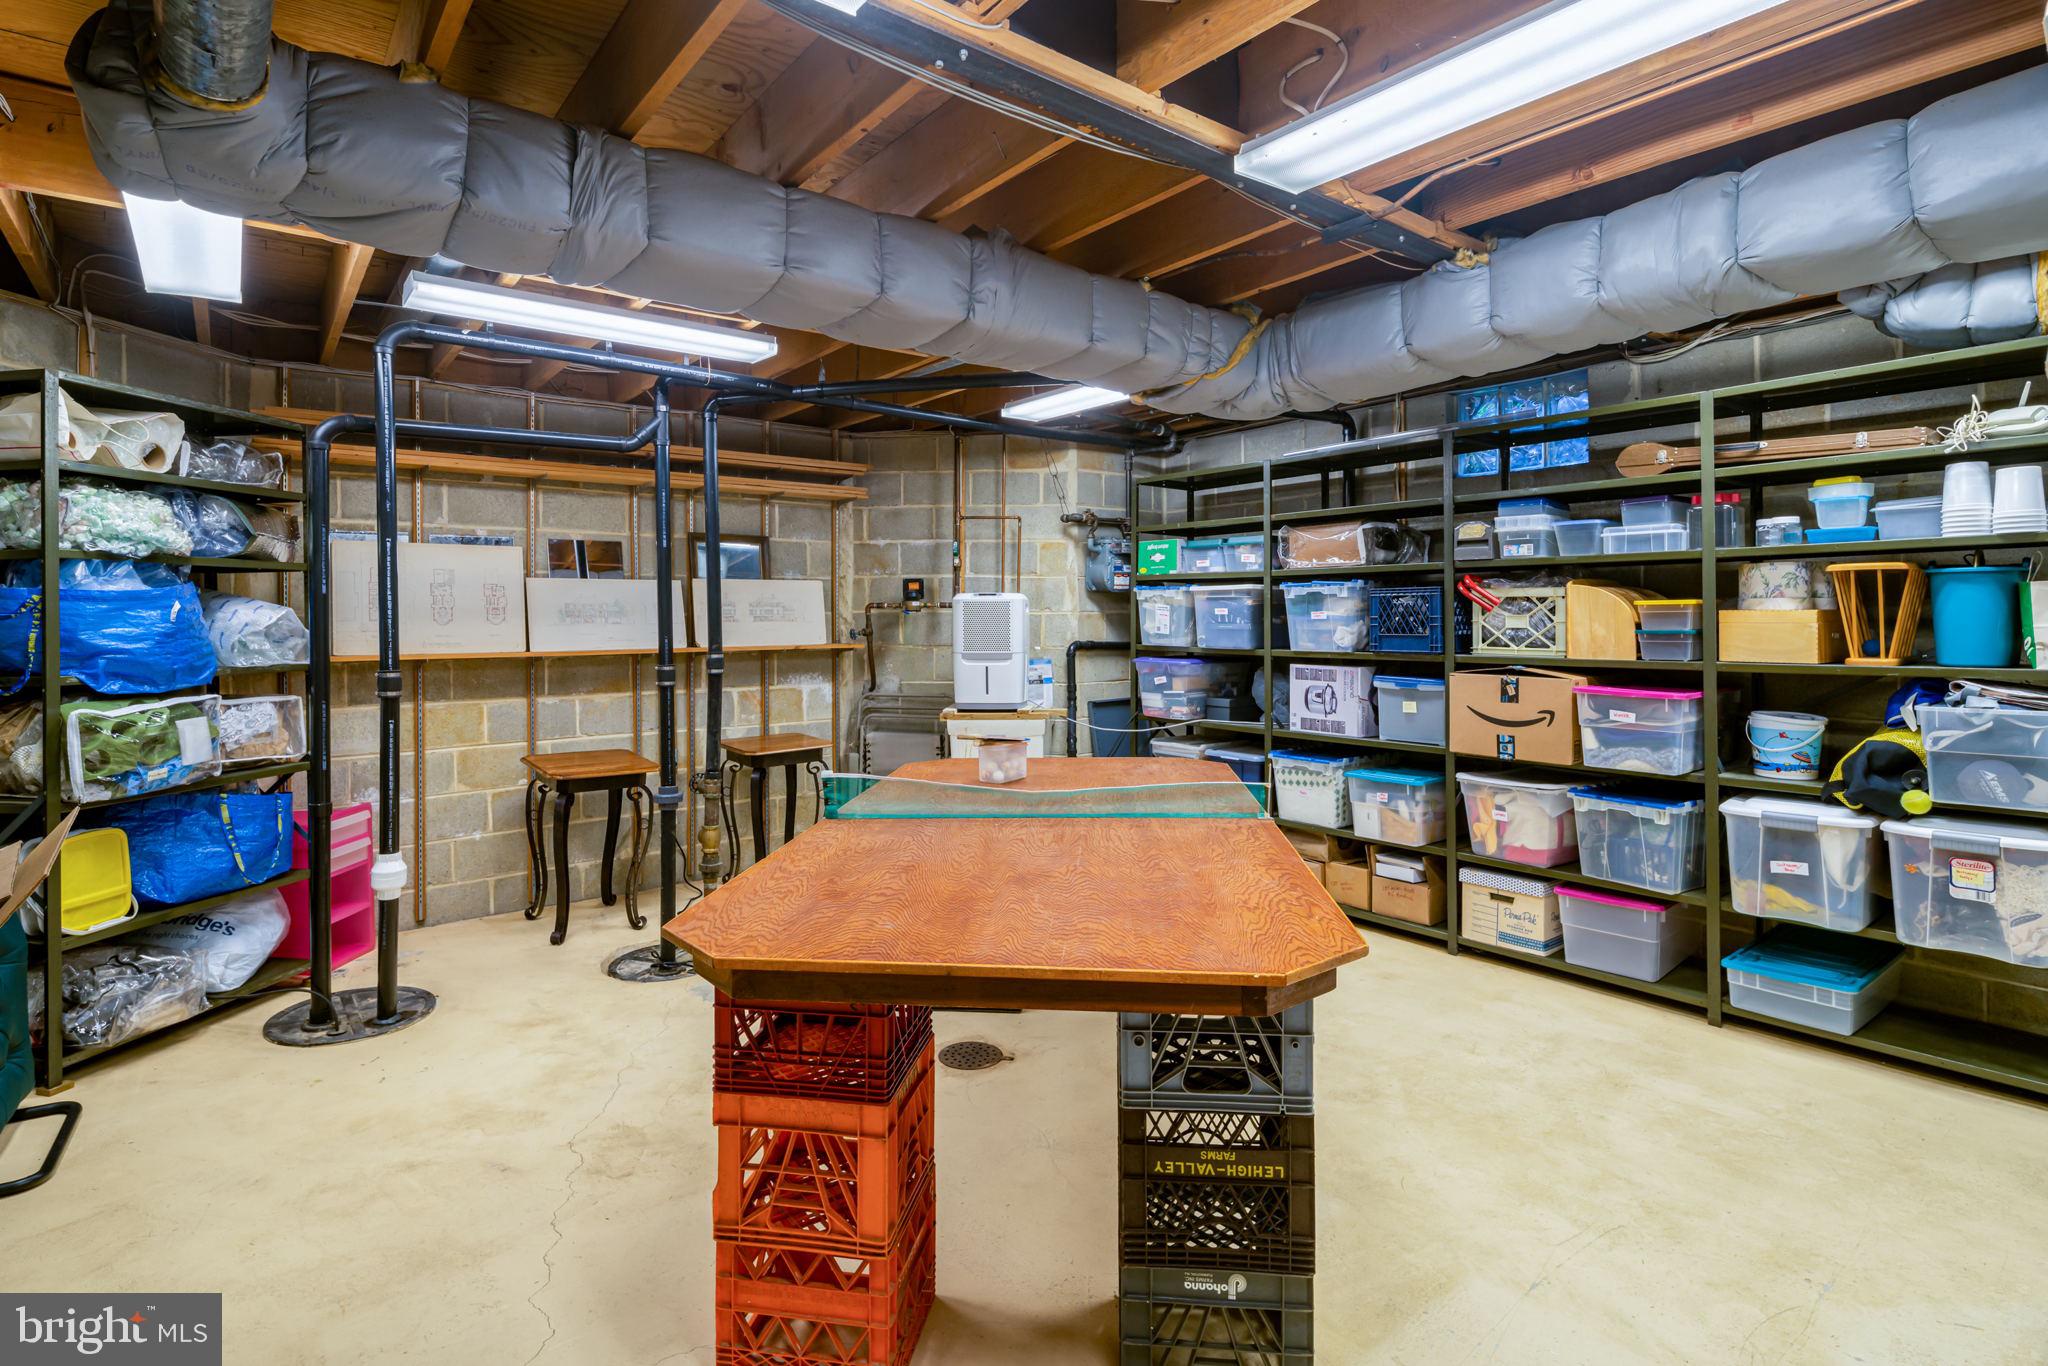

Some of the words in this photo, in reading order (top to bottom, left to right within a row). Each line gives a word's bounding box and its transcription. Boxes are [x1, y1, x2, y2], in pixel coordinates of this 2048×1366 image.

[1956, 860, 1990, 870] Sterilite
[1504, 907, 1522, 921] Perma
[1522, 911, 1537, 926] Pak
[1200, 1150, 1236, 1160] FARMS
[1154, 1161, 1284, 1179] LEHIGH-VALLEY
